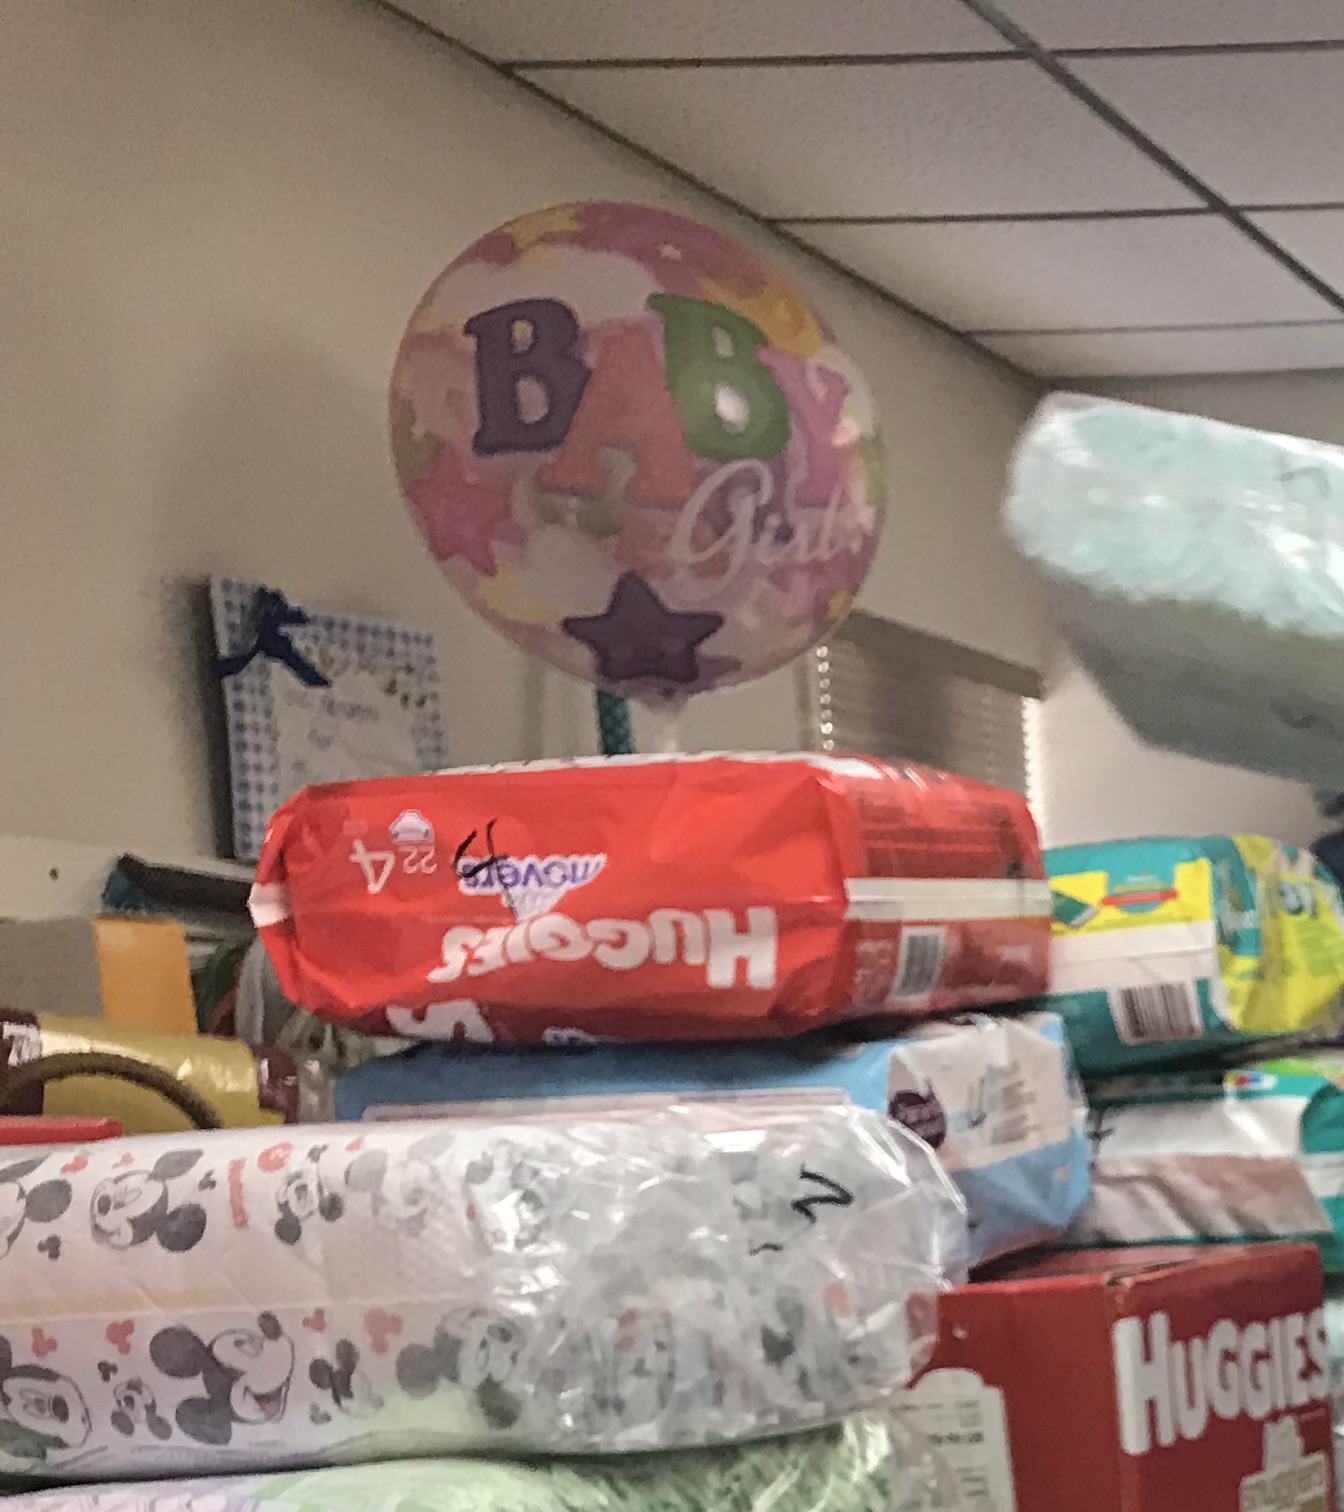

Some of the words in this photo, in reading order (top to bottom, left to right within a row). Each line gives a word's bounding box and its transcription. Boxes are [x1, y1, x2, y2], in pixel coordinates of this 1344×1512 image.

[464, 292, 851, 508] BABY
[350, 839, 394, 894] 4
[1112, 1307, 1329, 1456] HUGGIES
